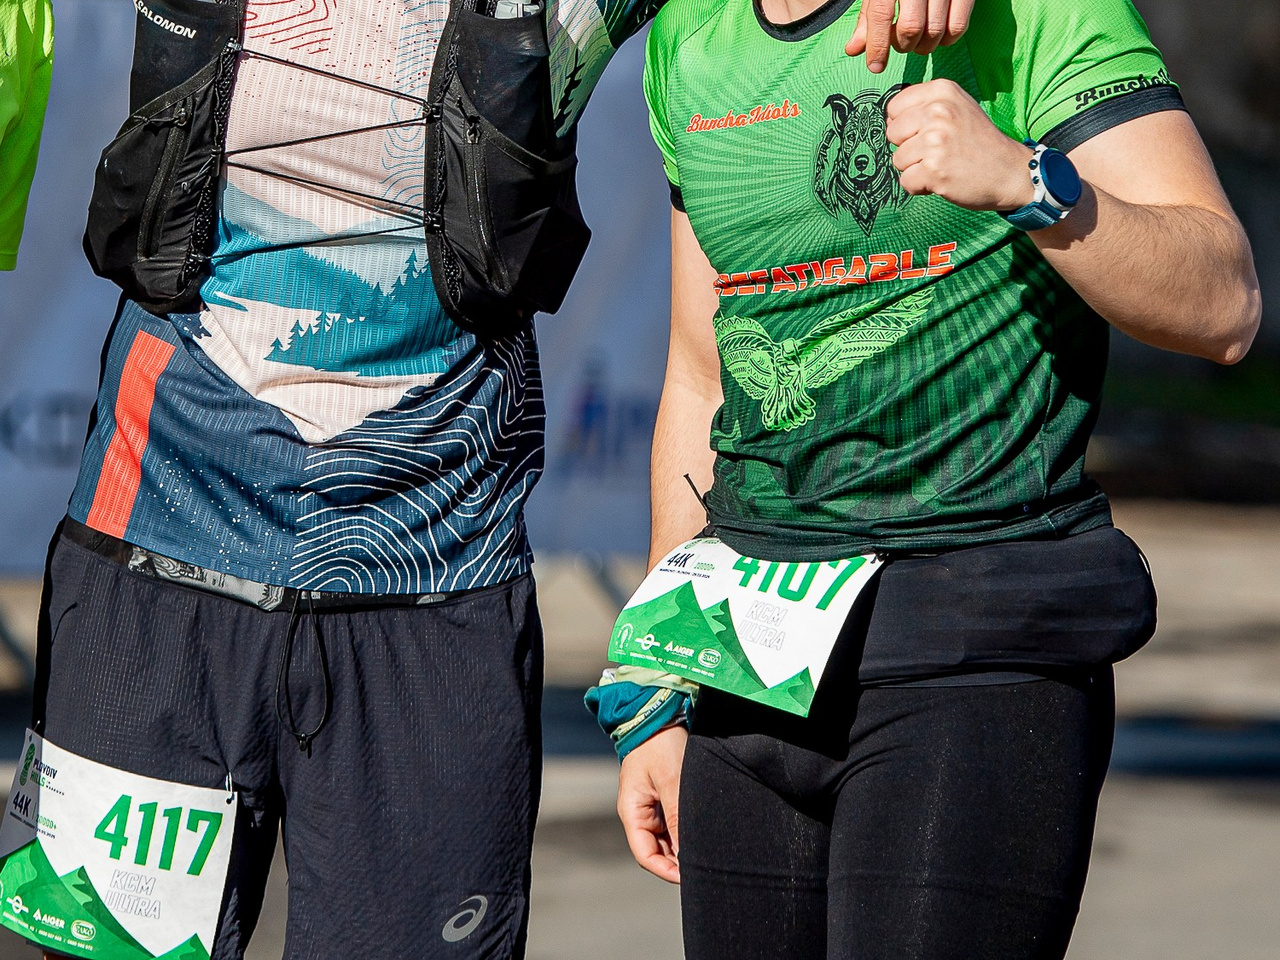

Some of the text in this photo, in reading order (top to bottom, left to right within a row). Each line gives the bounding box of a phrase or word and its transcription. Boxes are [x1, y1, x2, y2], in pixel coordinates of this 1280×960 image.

[137, 0, 197, 39] SALOMON
[712, 241, 958, 296] DEFATIGABLE
[667, 553, 695, 568] 44K
[732, 556, 867, 611] 4107
[745, 600, 788, 627] KCM
[738, 620, 786, 651] ULTRA
[13, 791, 32, 817] 44K
[94, 794, 223, 876] 4117
[109, 869, 157, 896] KCM
[105, 890, 161, 920] ULTRA
[41, 914, 66, 929] AIGER
